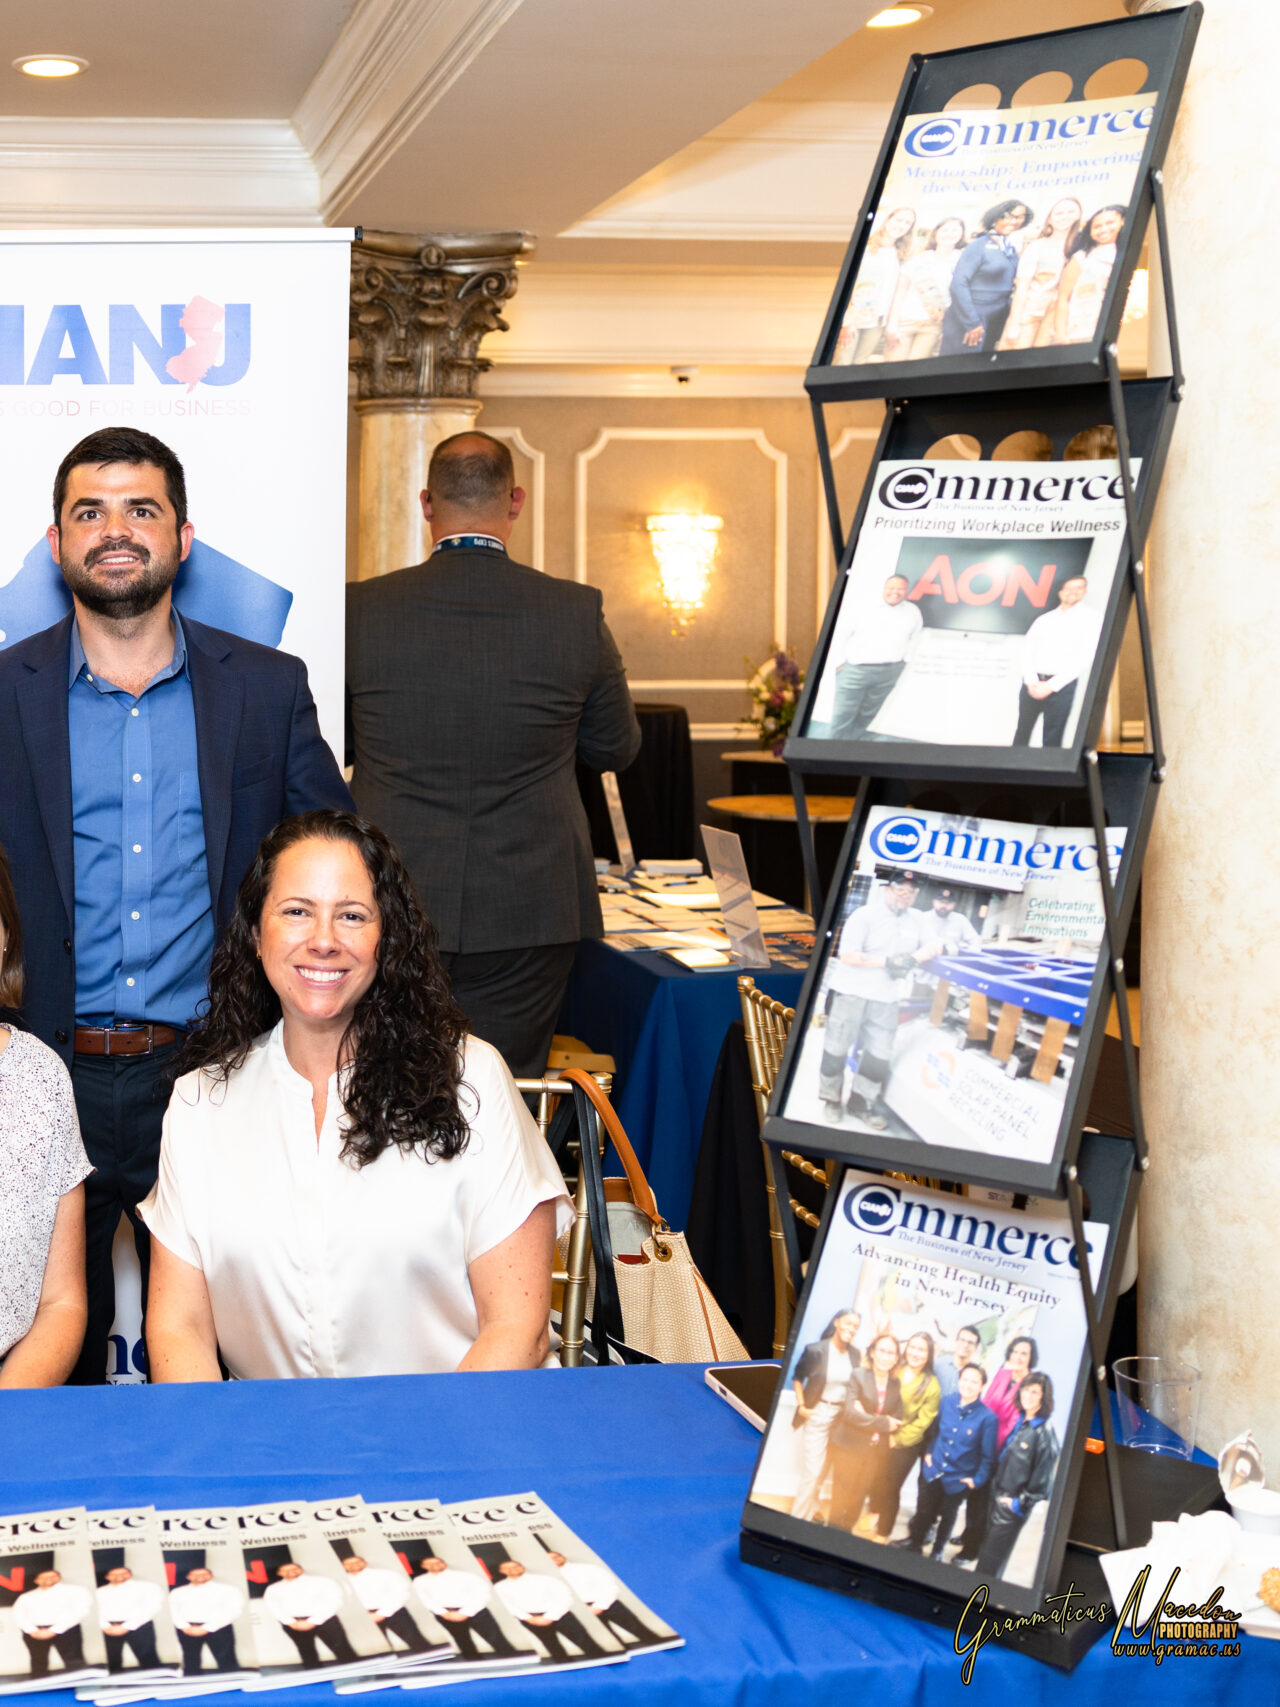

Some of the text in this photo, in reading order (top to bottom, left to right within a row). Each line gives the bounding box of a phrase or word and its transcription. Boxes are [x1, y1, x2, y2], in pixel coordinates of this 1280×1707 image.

[11, 400, 81, 418] GOOD
[88, 400, 135, 418] FOR
[143, 399, 252, 418] BUSINESS
[874, 516, 1121, 535] Prioritizing Workplace Wellness
[907, 554, 1058, 609] AON
[1027, 897, 1096, 914] Celebrating
[1022, 923, 1089, 938] Innovations
[897, 1230, 1029, 1274] The Business of New Jersey
[852, 1242, 1061, 1311] Advancing Health Equity
[895, 1272, 1010, 1318] in New Jersey
[7, 1539, 77, 1554] Wellness
[160, 1538, 228, 1549] Wellness
[240, 1532, 308, 1547] Wellness
